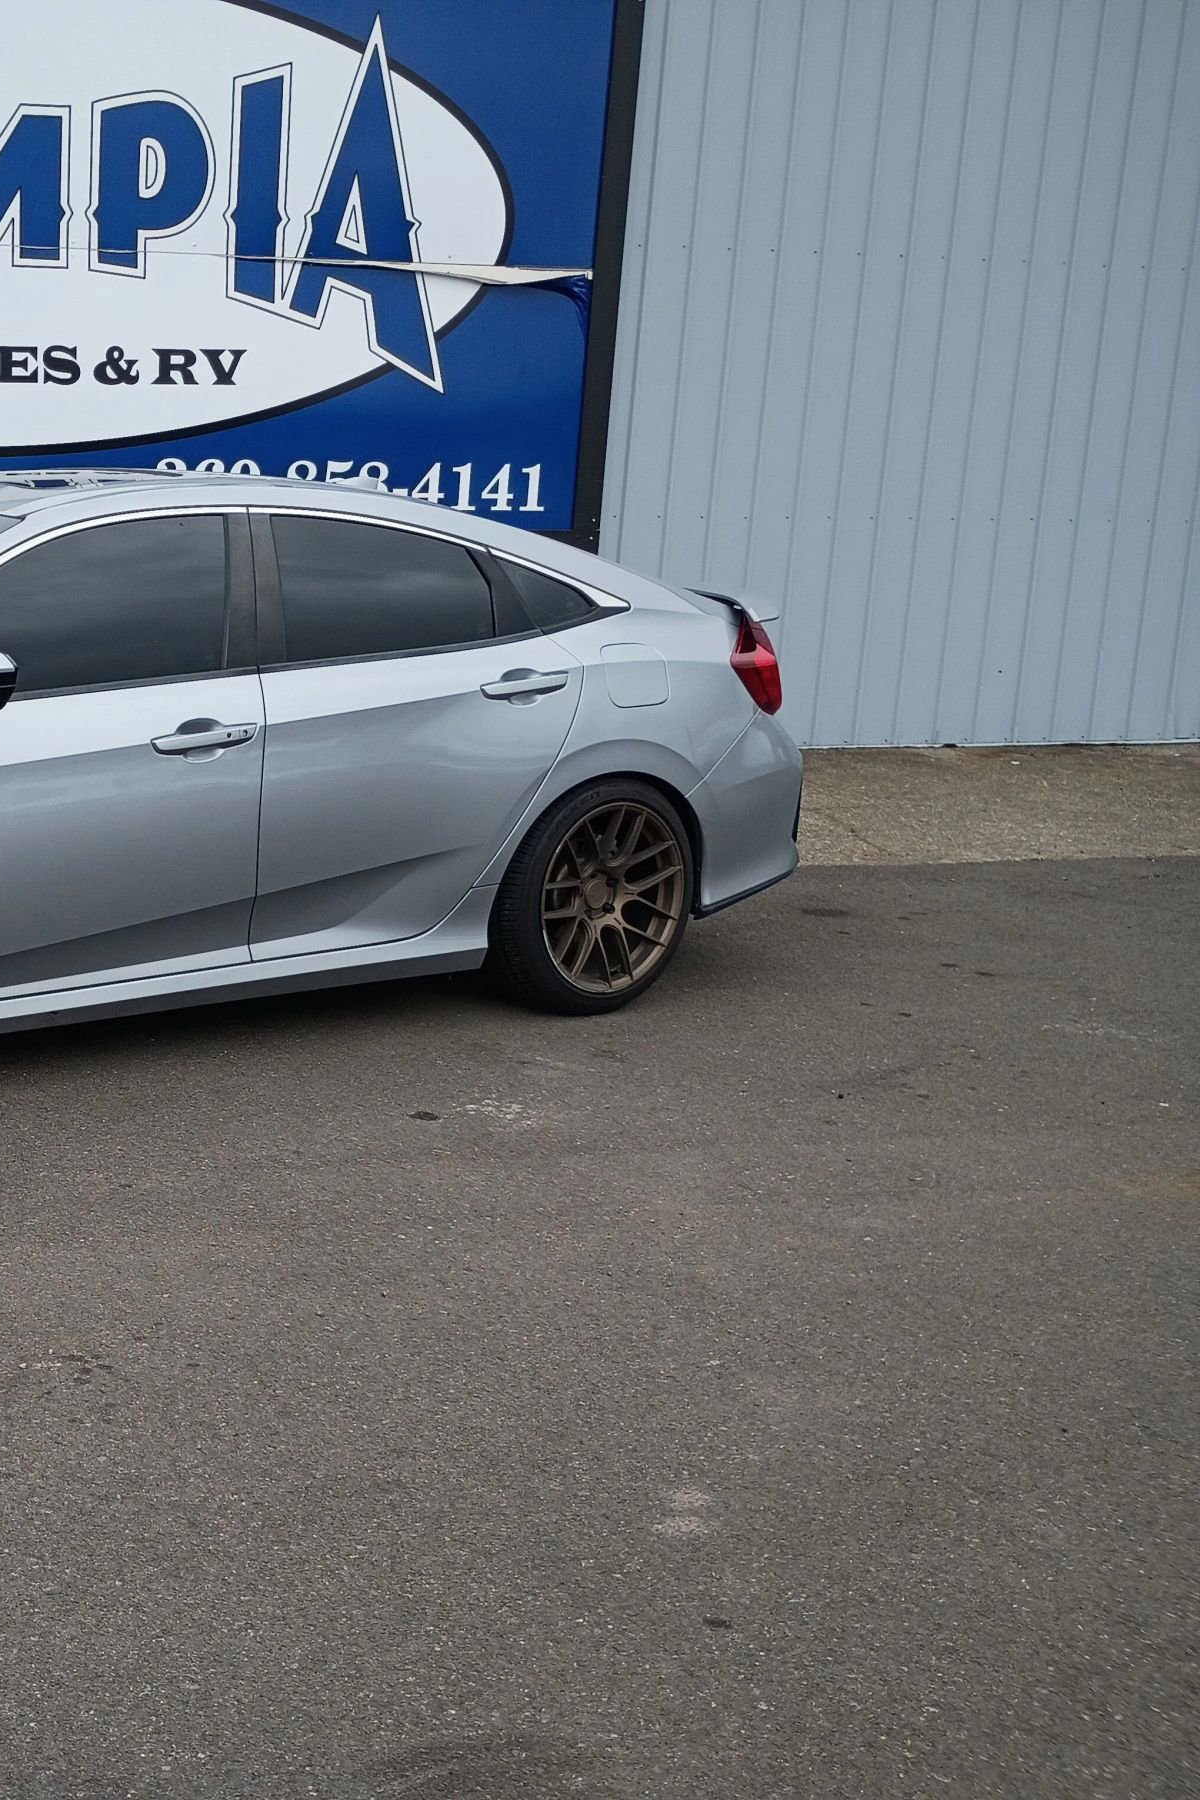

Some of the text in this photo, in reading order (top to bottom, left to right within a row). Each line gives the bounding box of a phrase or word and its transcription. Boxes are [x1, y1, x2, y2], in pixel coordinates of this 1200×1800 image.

[93, 344, 140, 385] &
[151, 348, 248, 385] RV
[155, 457, 546, 512] 8-4141
